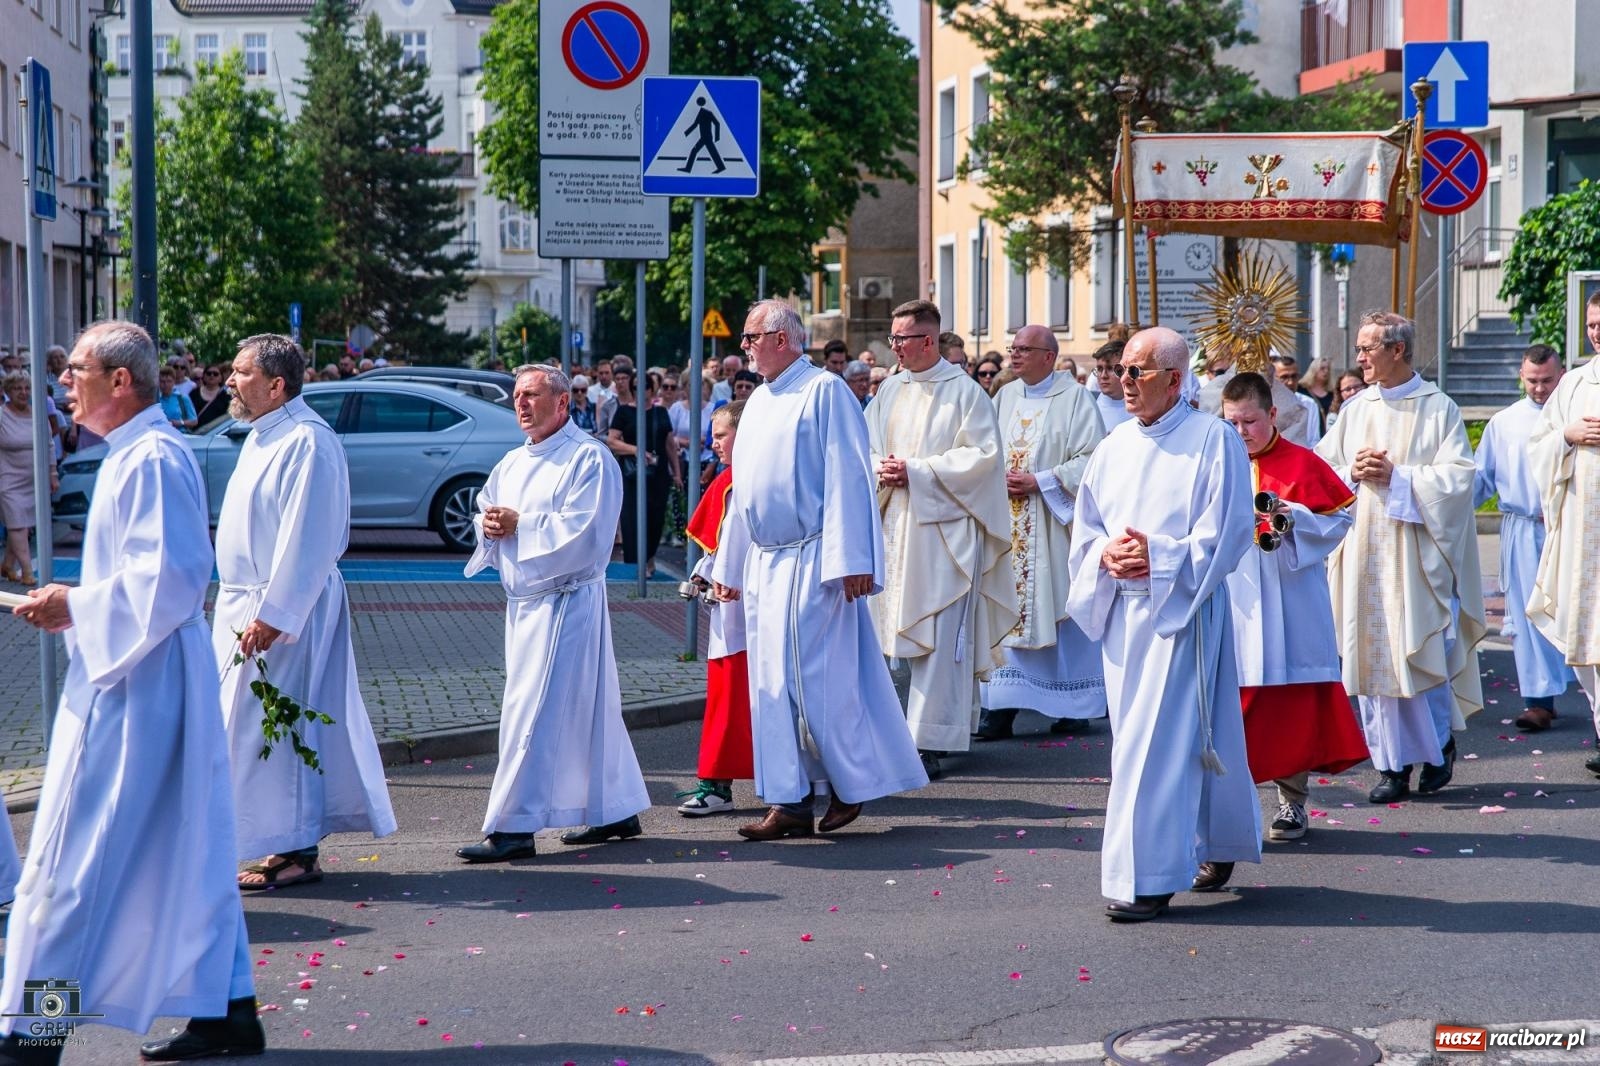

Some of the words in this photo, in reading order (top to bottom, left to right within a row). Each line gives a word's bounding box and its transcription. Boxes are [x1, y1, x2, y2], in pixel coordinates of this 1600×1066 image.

[576, 112, 626, 120] ograniczony
[567, 121, 590, 130] godz.
[594, 122, 612, 131] pon.
[622, 122, 634, 131] pt.
[556, 131, 580, 141] godz.
[582, 131, 601, 139] 9.00
[611, 132, 633, 140] 17.00
[549, 171, 567, 179] Karty
[569, 172, 609, 180] parkingowe
[563, 187, 584, 195] Biurze
